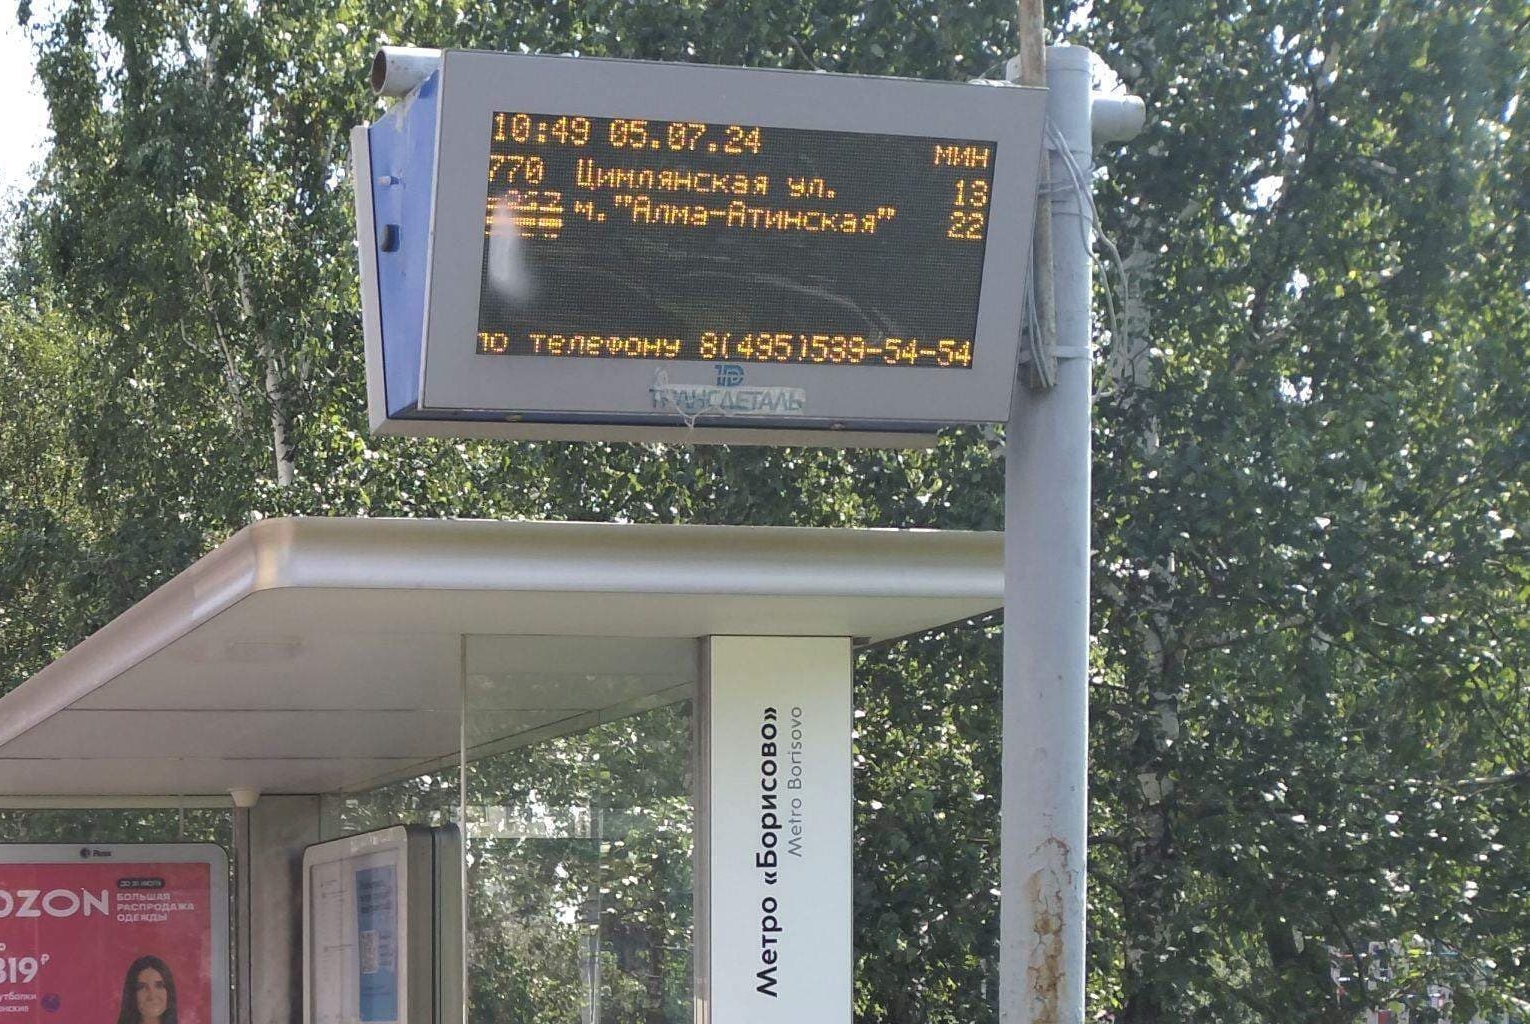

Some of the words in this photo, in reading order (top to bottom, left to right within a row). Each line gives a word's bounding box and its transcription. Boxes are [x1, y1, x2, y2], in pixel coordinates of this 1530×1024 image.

[494, 112, 592, 146] 10:49
[609, 119, 763, 154] 05.07.24
[489, 154, 545, 185] 770
[575, 157, 769, 196] Цимлянская
[786, 176, 837, 199] ул.
[953, 178, 990, 207] 13
[945, 209, 986, 240] 22
[528, 333, 682, 359] телефону
[787, 705, 803, 790] Borisovo
[756, 705, 782, 886] «Борисово»
[787, 797, 803, 858] Metro
[116, 893, 171, 901] БОЛЬШАЯ
[116, 903, 195, 912] РАСПРОДАЖА
[116, 913, 168, 922] ОДЕЖДЫ
[756, 896, 782, 998] Метро
